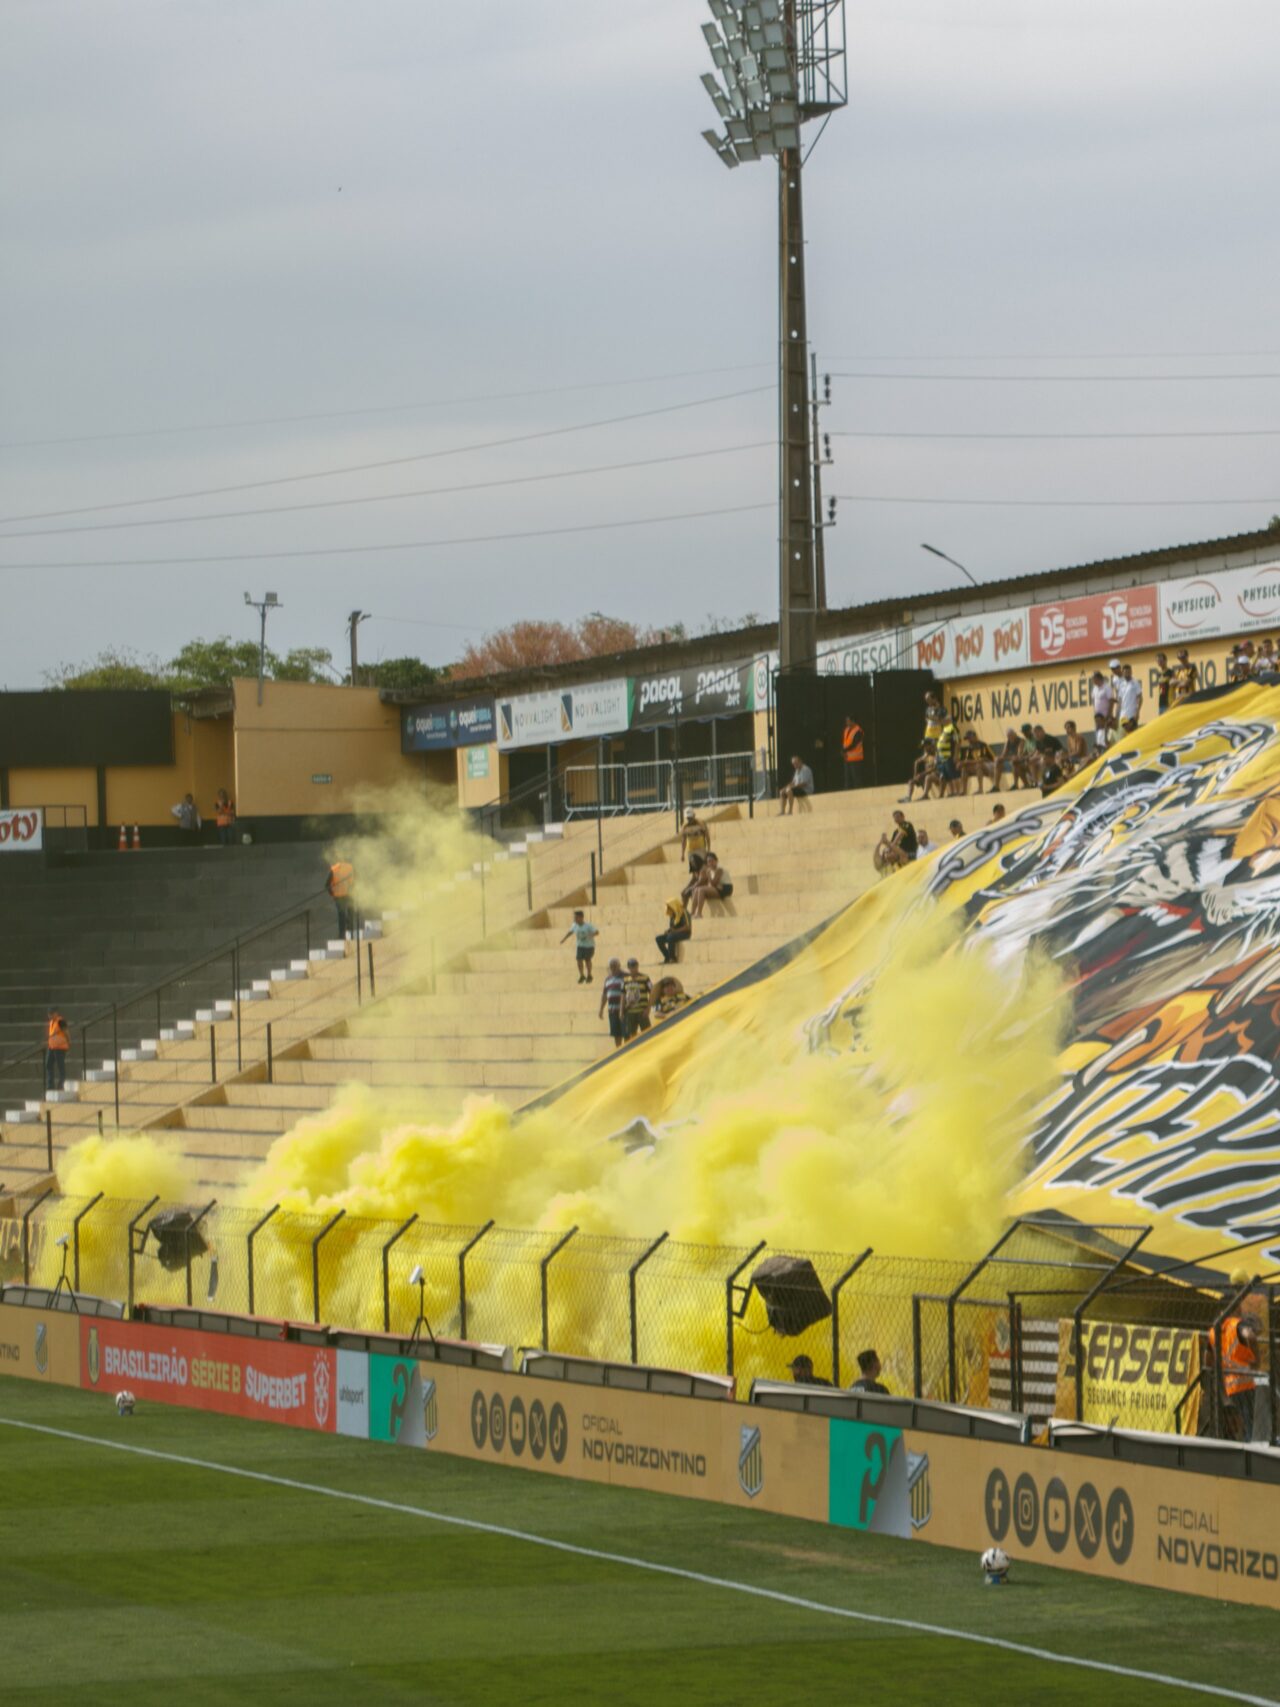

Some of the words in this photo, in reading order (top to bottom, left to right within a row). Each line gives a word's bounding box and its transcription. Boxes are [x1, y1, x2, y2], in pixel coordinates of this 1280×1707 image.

[1171, 595, 1216, 615] PHYSICUS
[951, 691, 984, 723] DIGA
[991, 680, 1022, 718] NÃO
[0, 812, 38, 843] oty
[1064, 1321, 1193, 1386] SERSEG
[104, 1346, 188, 1387] BRASILEIRÃO
[191, 1352, 230, 1391] SÉRIE
[232, 1363, 242, 1394] B
[245, 1364, 307, 1409] SUPERBET
[1130, 1390, 1168, 1412] PRIVADA
[582, 1413, 623, 1436] OFICIAL
[582, 1437, 706, 1478] NOVORIZONTINO
[1157, 1504, 1220, 1535] OFICIAL
